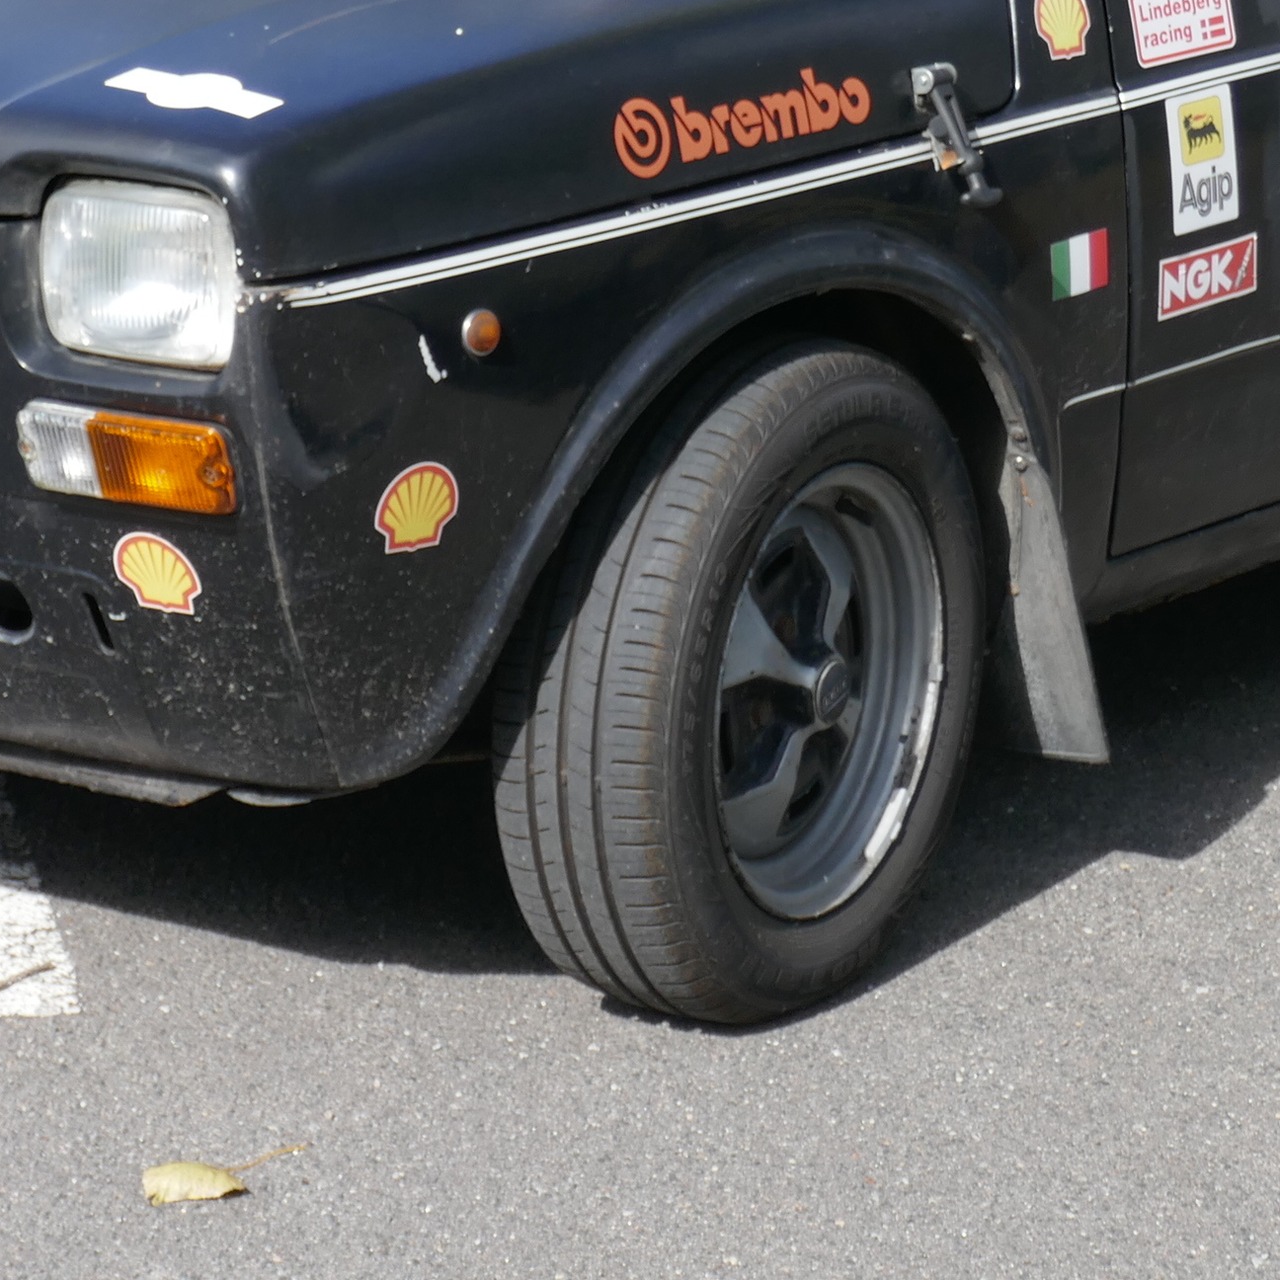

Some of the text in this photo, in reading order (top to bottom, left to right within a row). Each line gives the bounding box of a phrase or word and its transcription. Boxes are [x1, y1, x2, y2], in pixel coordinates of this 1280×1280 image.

[1144, 23, 1193, 48] racing
[670, 67, 871, 163] brembo
[1179, 165, 1233, 217] Agip
[1163, 248, 1236, 310] NGK
